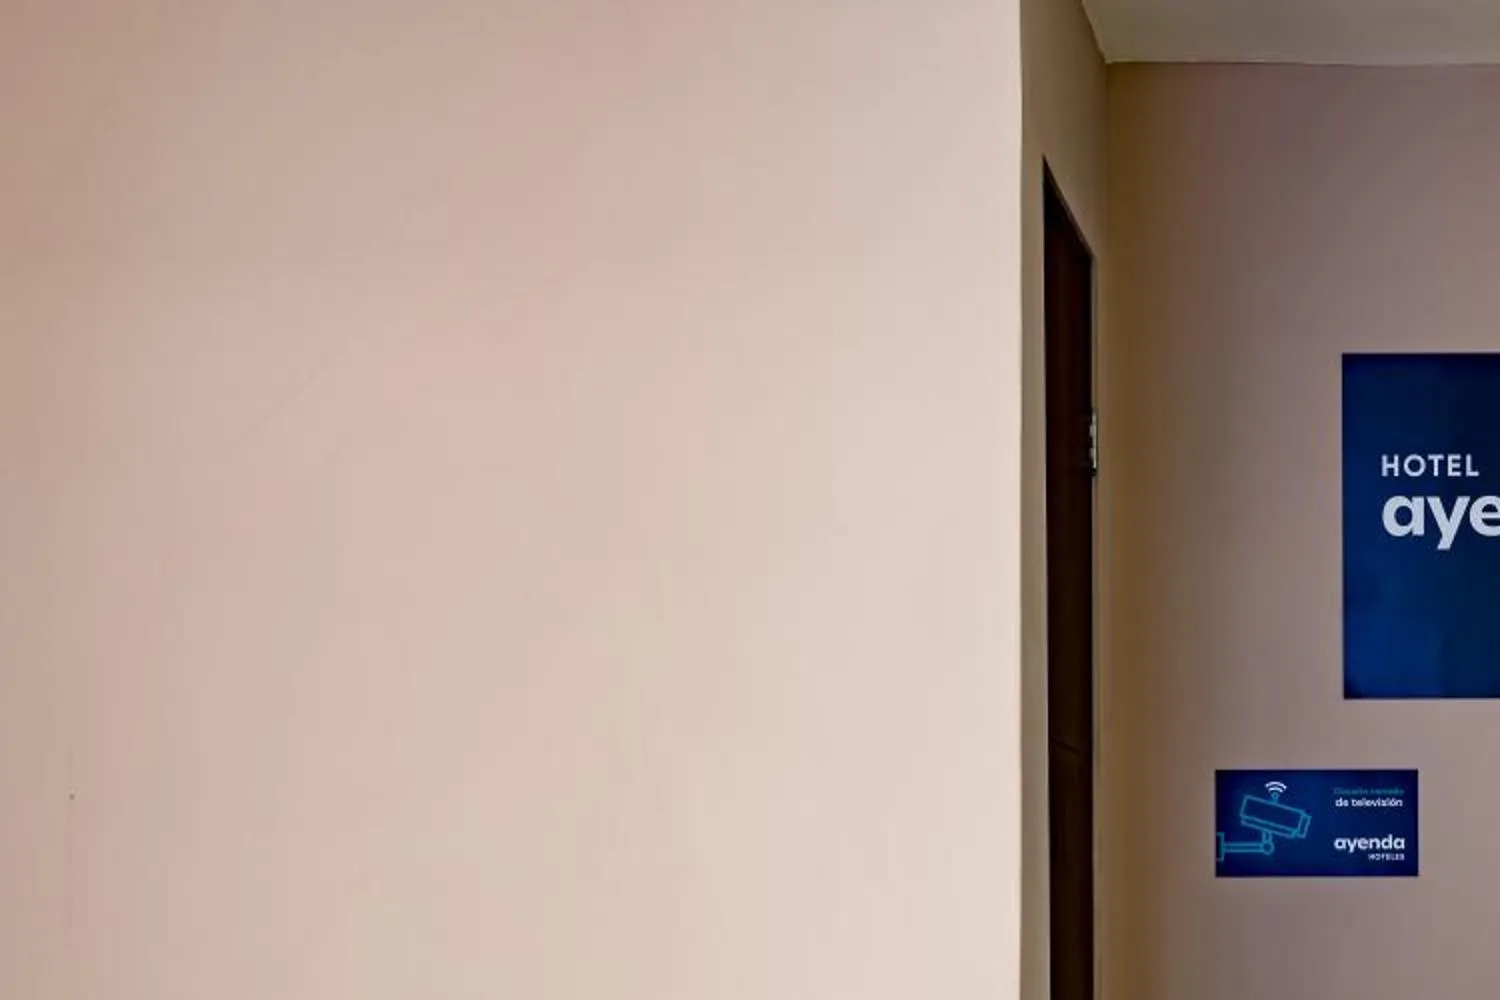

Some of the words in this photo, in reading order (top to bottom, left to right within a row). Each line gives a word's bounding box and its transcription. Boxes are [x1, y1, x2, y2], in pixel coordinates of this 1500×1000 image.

[1381, 454, 1480, 477] HOTEL
[1335, 797, 1349, 807] de
[1351, 797, 1404, 807] televisión
[1333, 834, 1406, 853] ayenda
